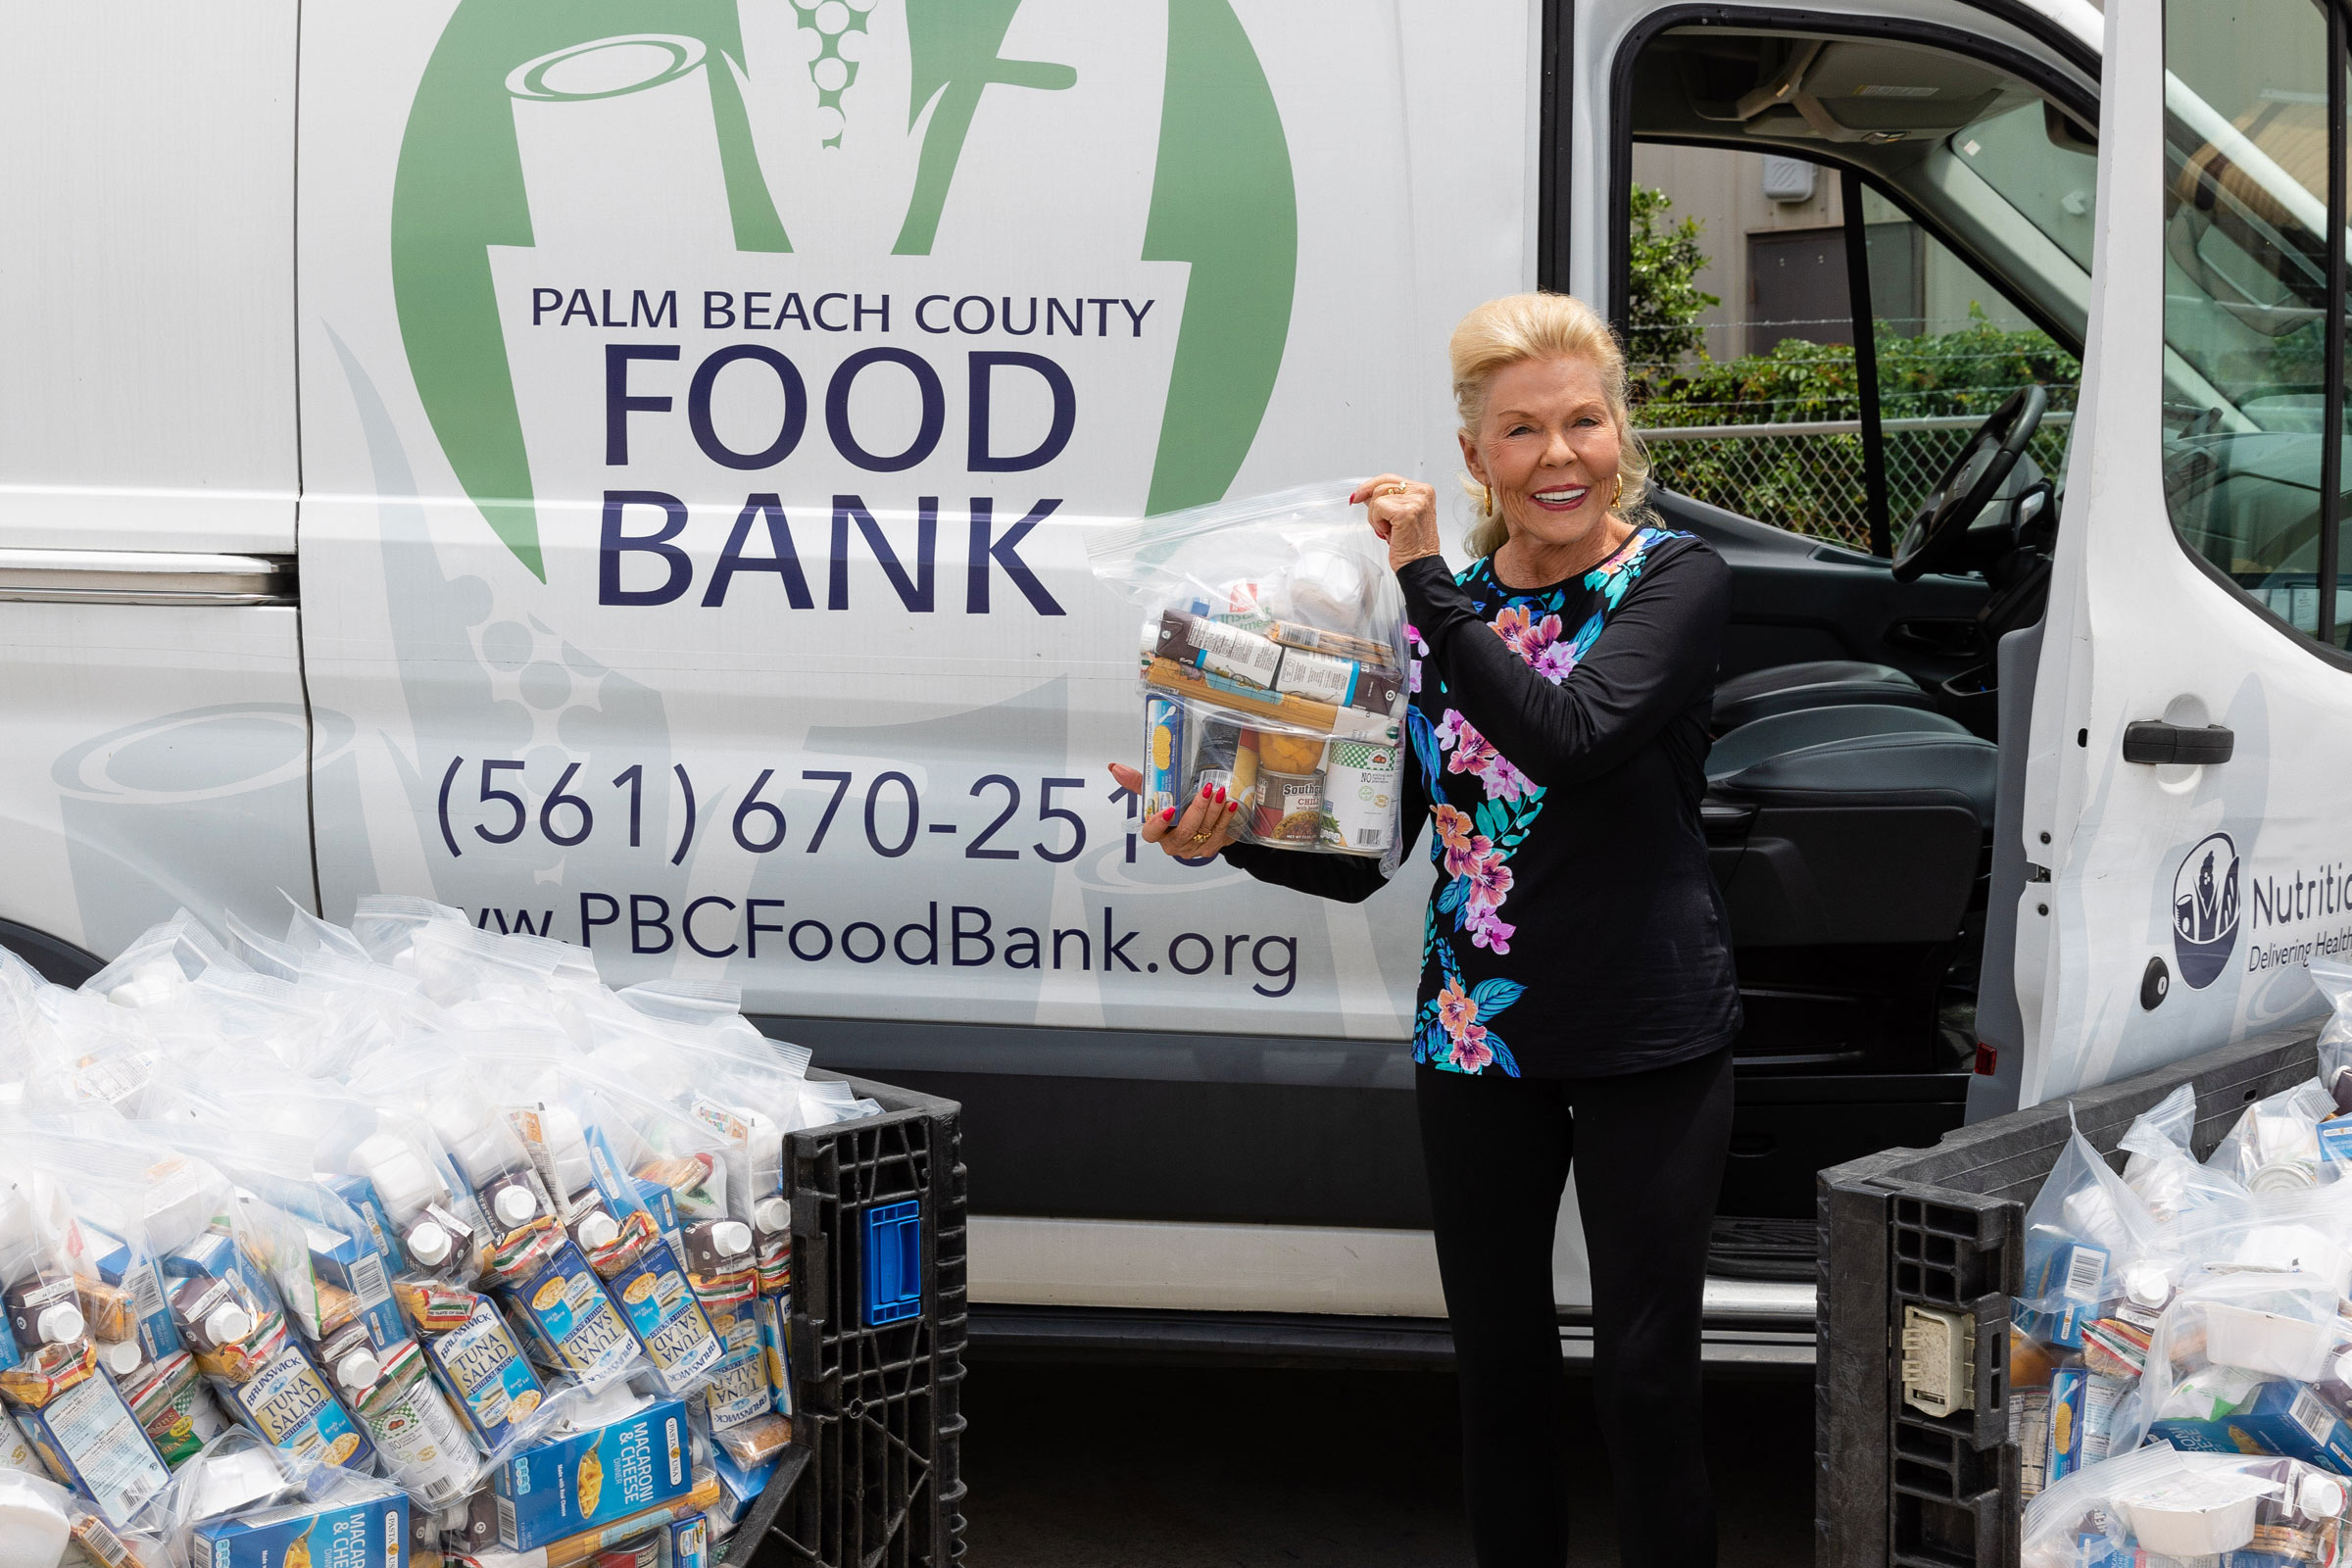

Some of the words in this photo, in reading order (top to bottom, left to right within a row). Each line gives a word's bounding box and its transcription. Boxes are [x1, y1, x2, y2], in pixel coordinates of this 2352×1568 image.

[532, 287, 678, 328] PALM
[703, 291, 891, 333] BEACH
[914, 294, 1155, 338] COUNTY
[605, 343, 1076, 472] FOOD
[599, 489, 1067, 615] BANK
[1360, 772, 1372, 784] NO
[438, 756, 696, 866] (561)
[732, 768, 1220, 868] 670-251
[2249, 939, 2311, 969] Delivering
[441, 1313, 492, 1359] BRUNSWICK
[569, 1311, 612, 1354] SALAD
[578, 1327, 621, 1365] TUNA
[654, 1310, 698, 1350] SALAD
[661, 1324, 705, 1363] TUNA
[455, 1332, 501, 1371] TUNA
[462, 1344, 509, 1389] SALAD
[667, 1341, 716, 1382] BRUNSWICK
[246, 1356, 300, 1406] BRUNSWICK
[263, 1377, 312, 1418] TUNA
[717, 1378, 760, 1403] TUNA
[271, 1387, 321, 1436] SALAD
[716, 1395, 768, 1423] BRUNSWICK
[162, 1432, 192, 1454] BEANS
[284, 1424, 300, 1439] WITH
[619, 1432, 634, 1444] &
[668, 1424, 677, 1448] PASTA
[613, 1458, 623, 1485] DINNER
[621, 1446, 639, 1504] CHEESE
[634, 1421, 654, 1503] MACARONI
[670, 1460, 679, 1478] USA
[333, 1522, 344, 1536] &
